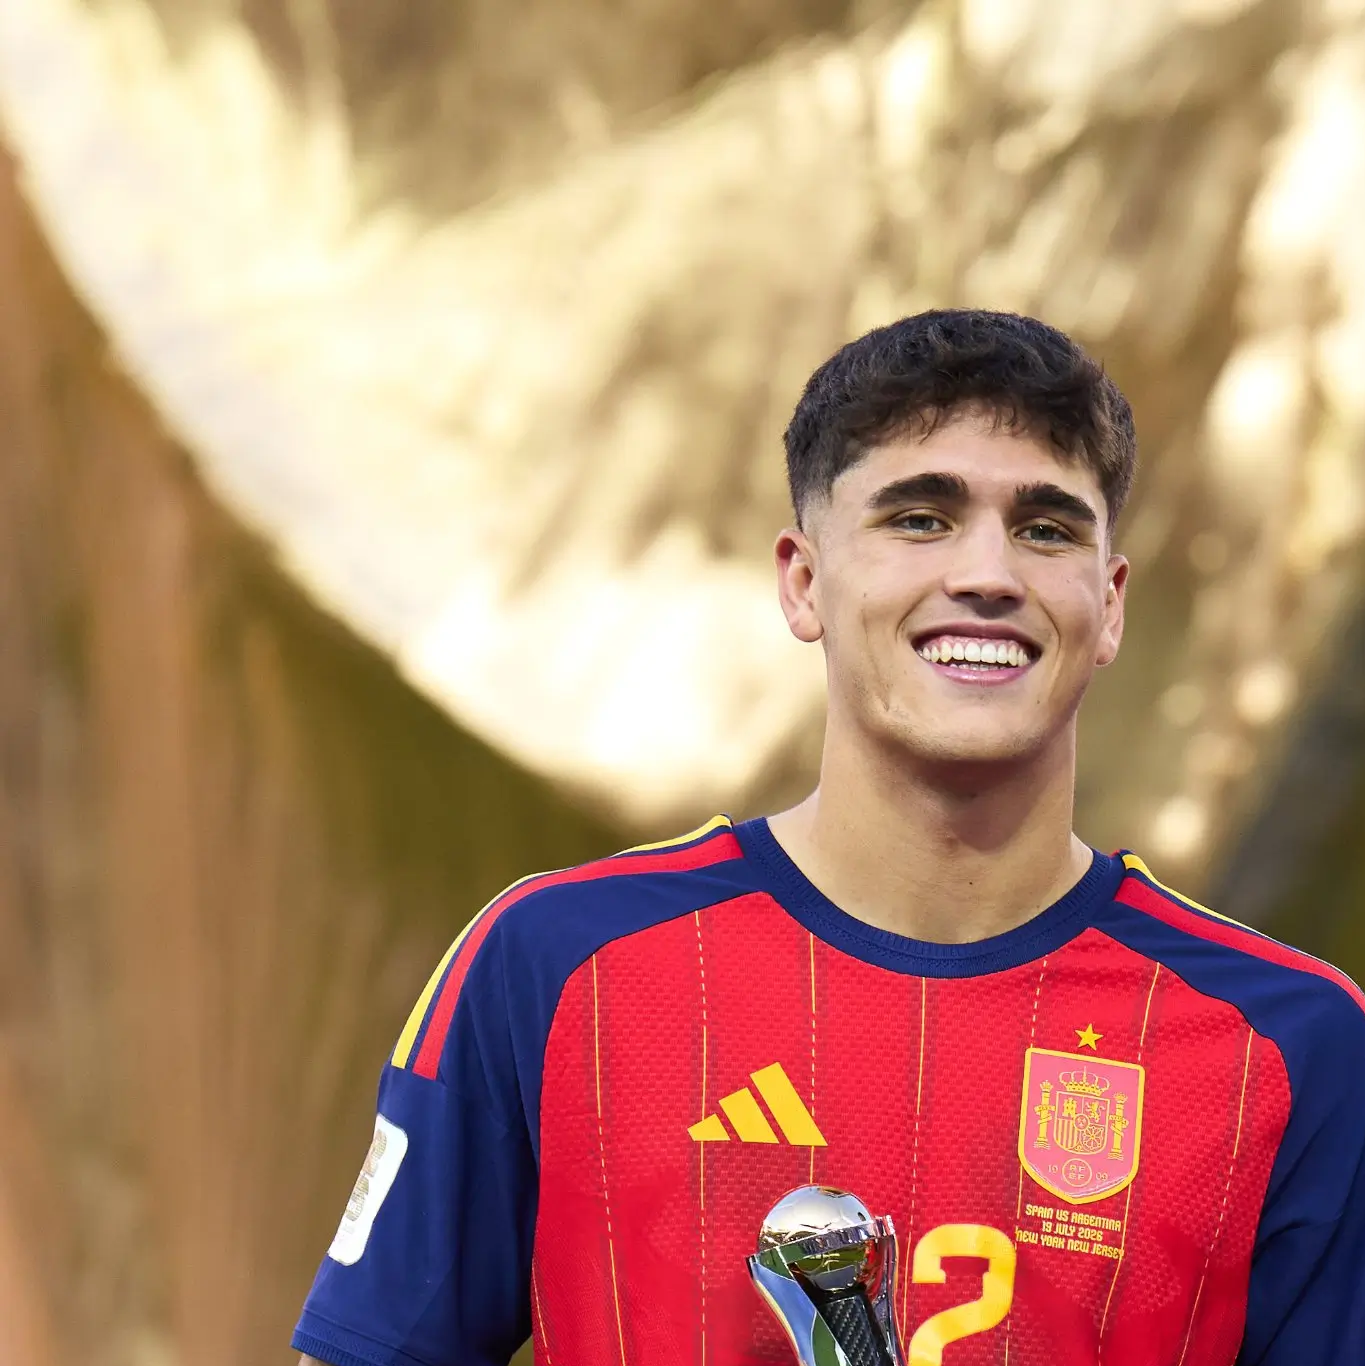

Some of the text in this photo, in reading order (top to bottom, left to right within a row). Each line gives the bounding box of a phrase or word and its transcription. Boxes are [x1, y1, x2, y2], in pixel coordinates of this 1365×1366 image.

[1026, 1204, 1053, 1219] SPAIN
[1071, 1212, 1121, 1232] ARGENTINA
[1042, 1221, 1103, 1241] 19 JULY 2026
[1016, 1229, 1124, 1259] NEW YORK NEW JERSEY
